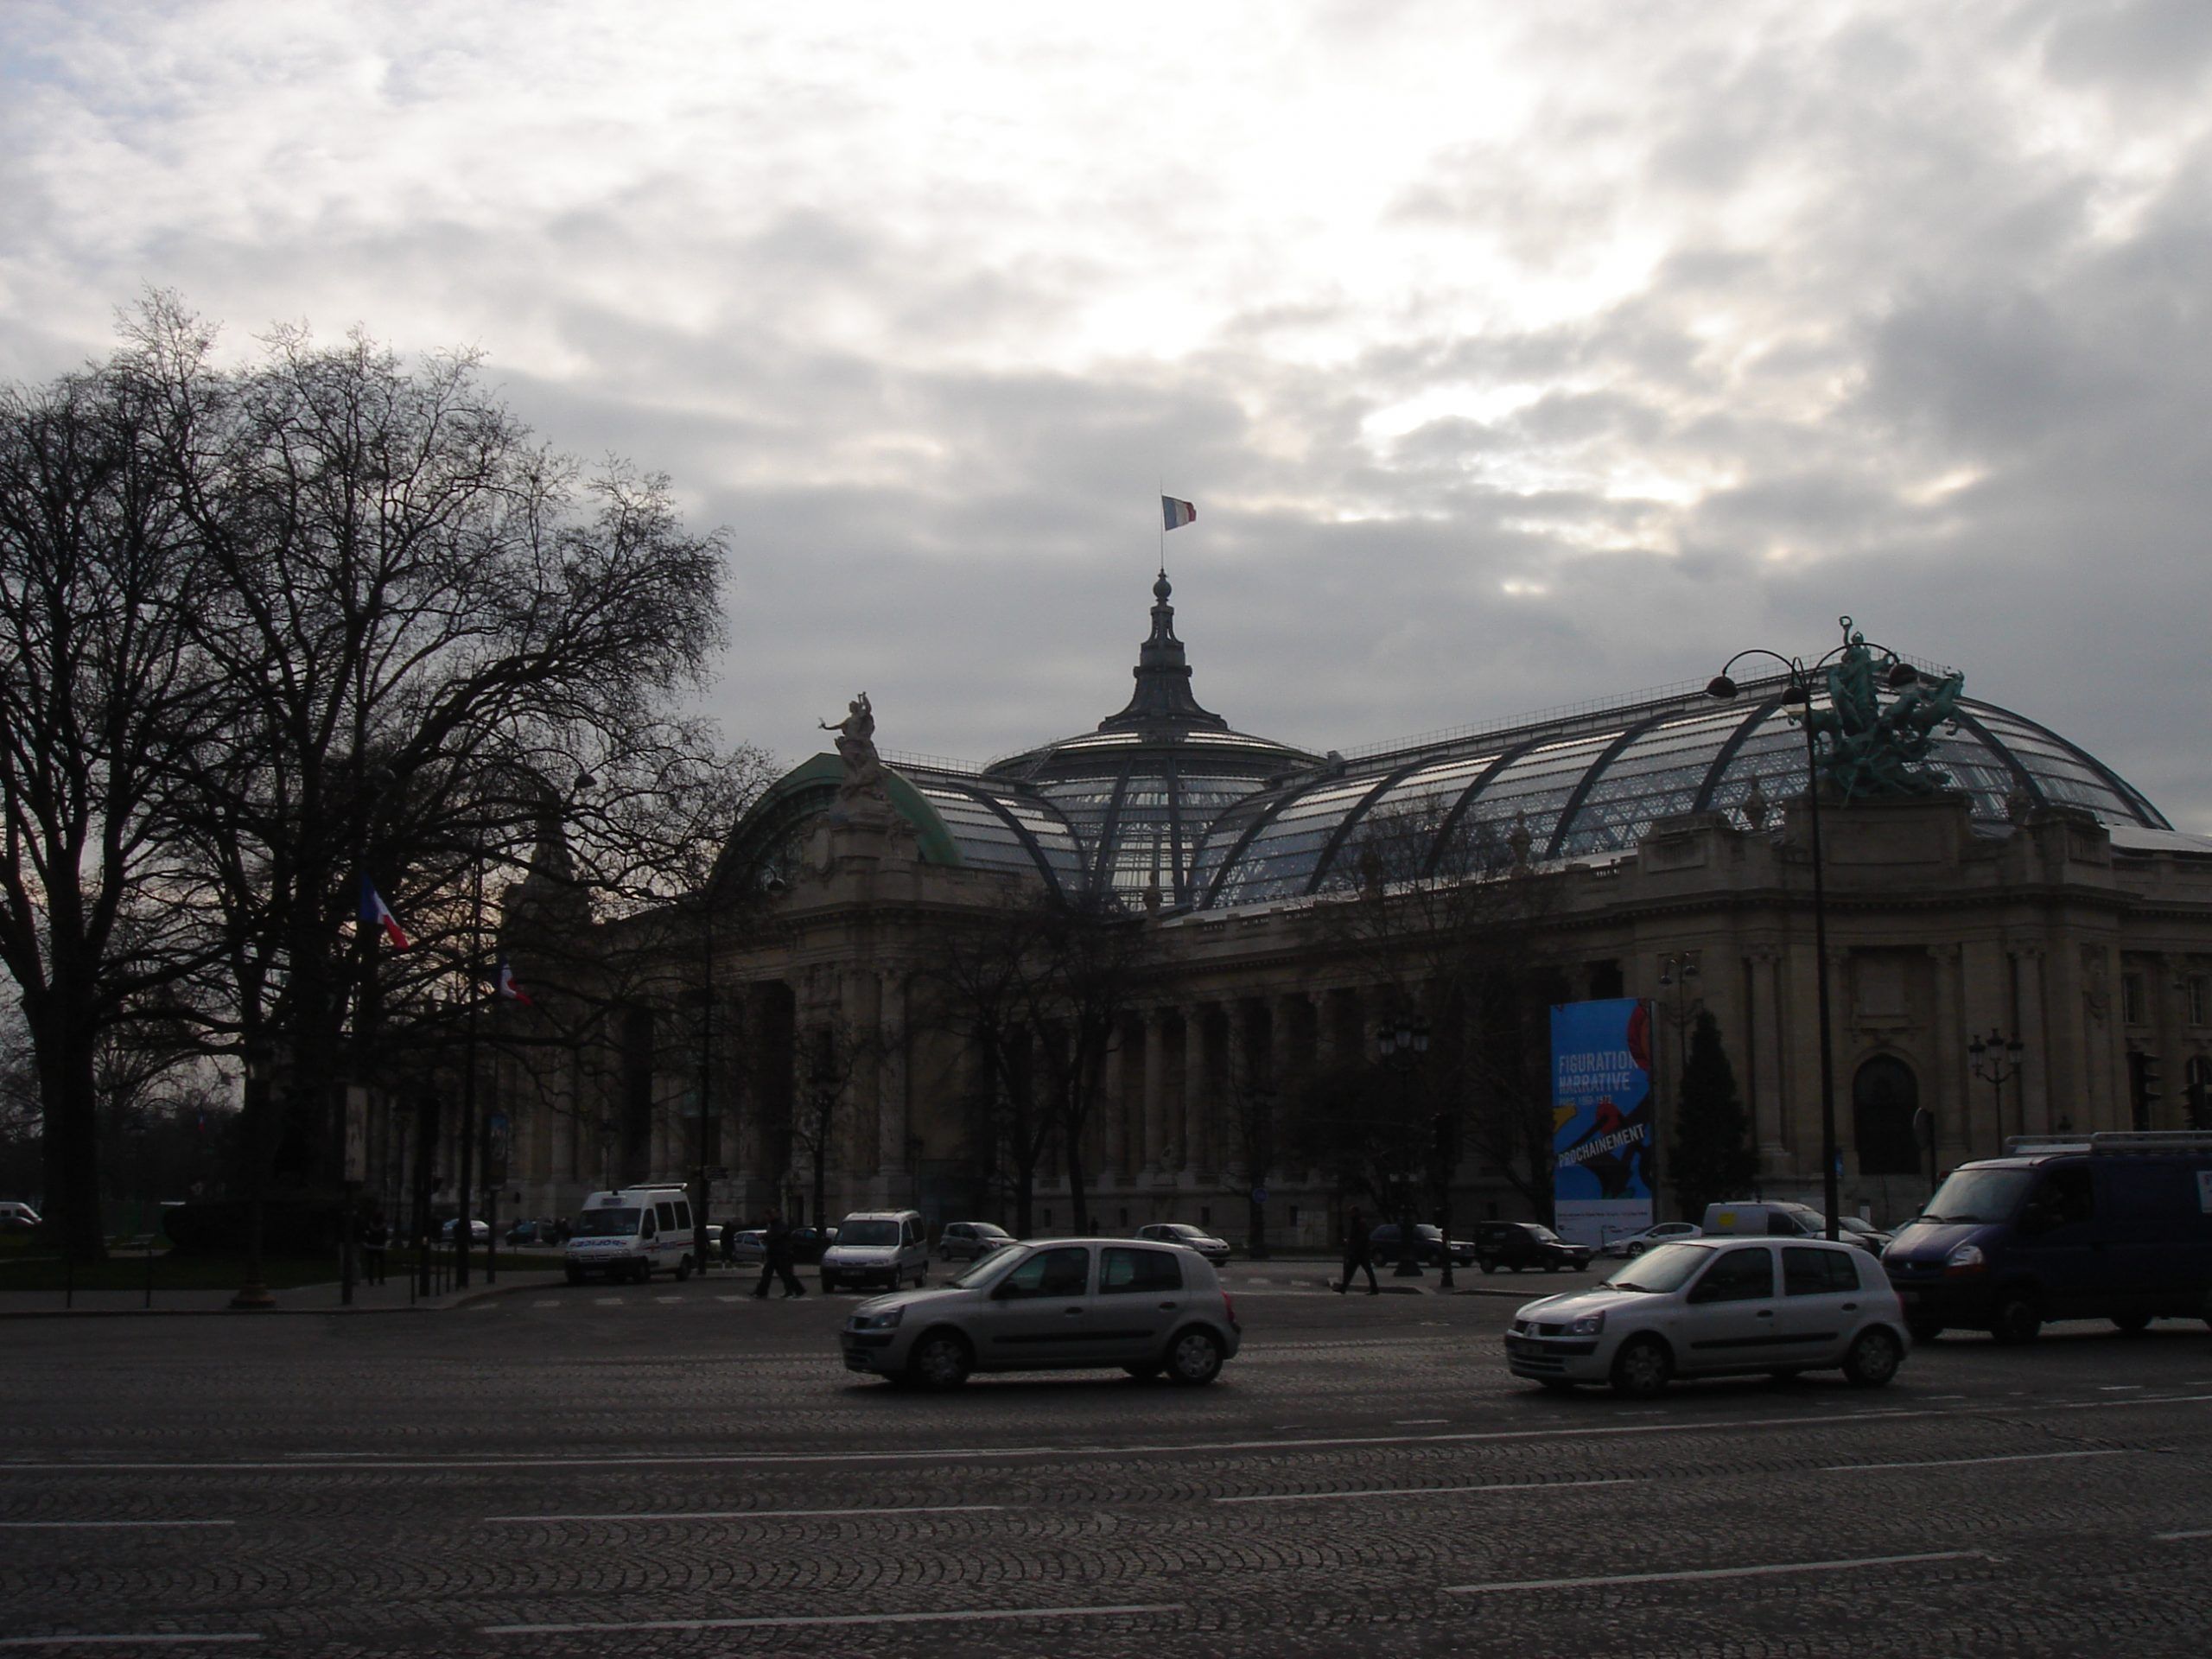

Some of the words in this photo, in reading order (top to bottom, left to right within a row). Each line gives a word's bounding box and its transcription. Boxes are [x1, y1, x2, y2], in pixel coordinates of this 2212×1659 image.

[1559, 1050, 1639, 1074] FIGURATION
[1559, 1071, 1631, 1095] NARRATIVE
[1558, 1123, 1645, 1168] PROCHAINEMENT
